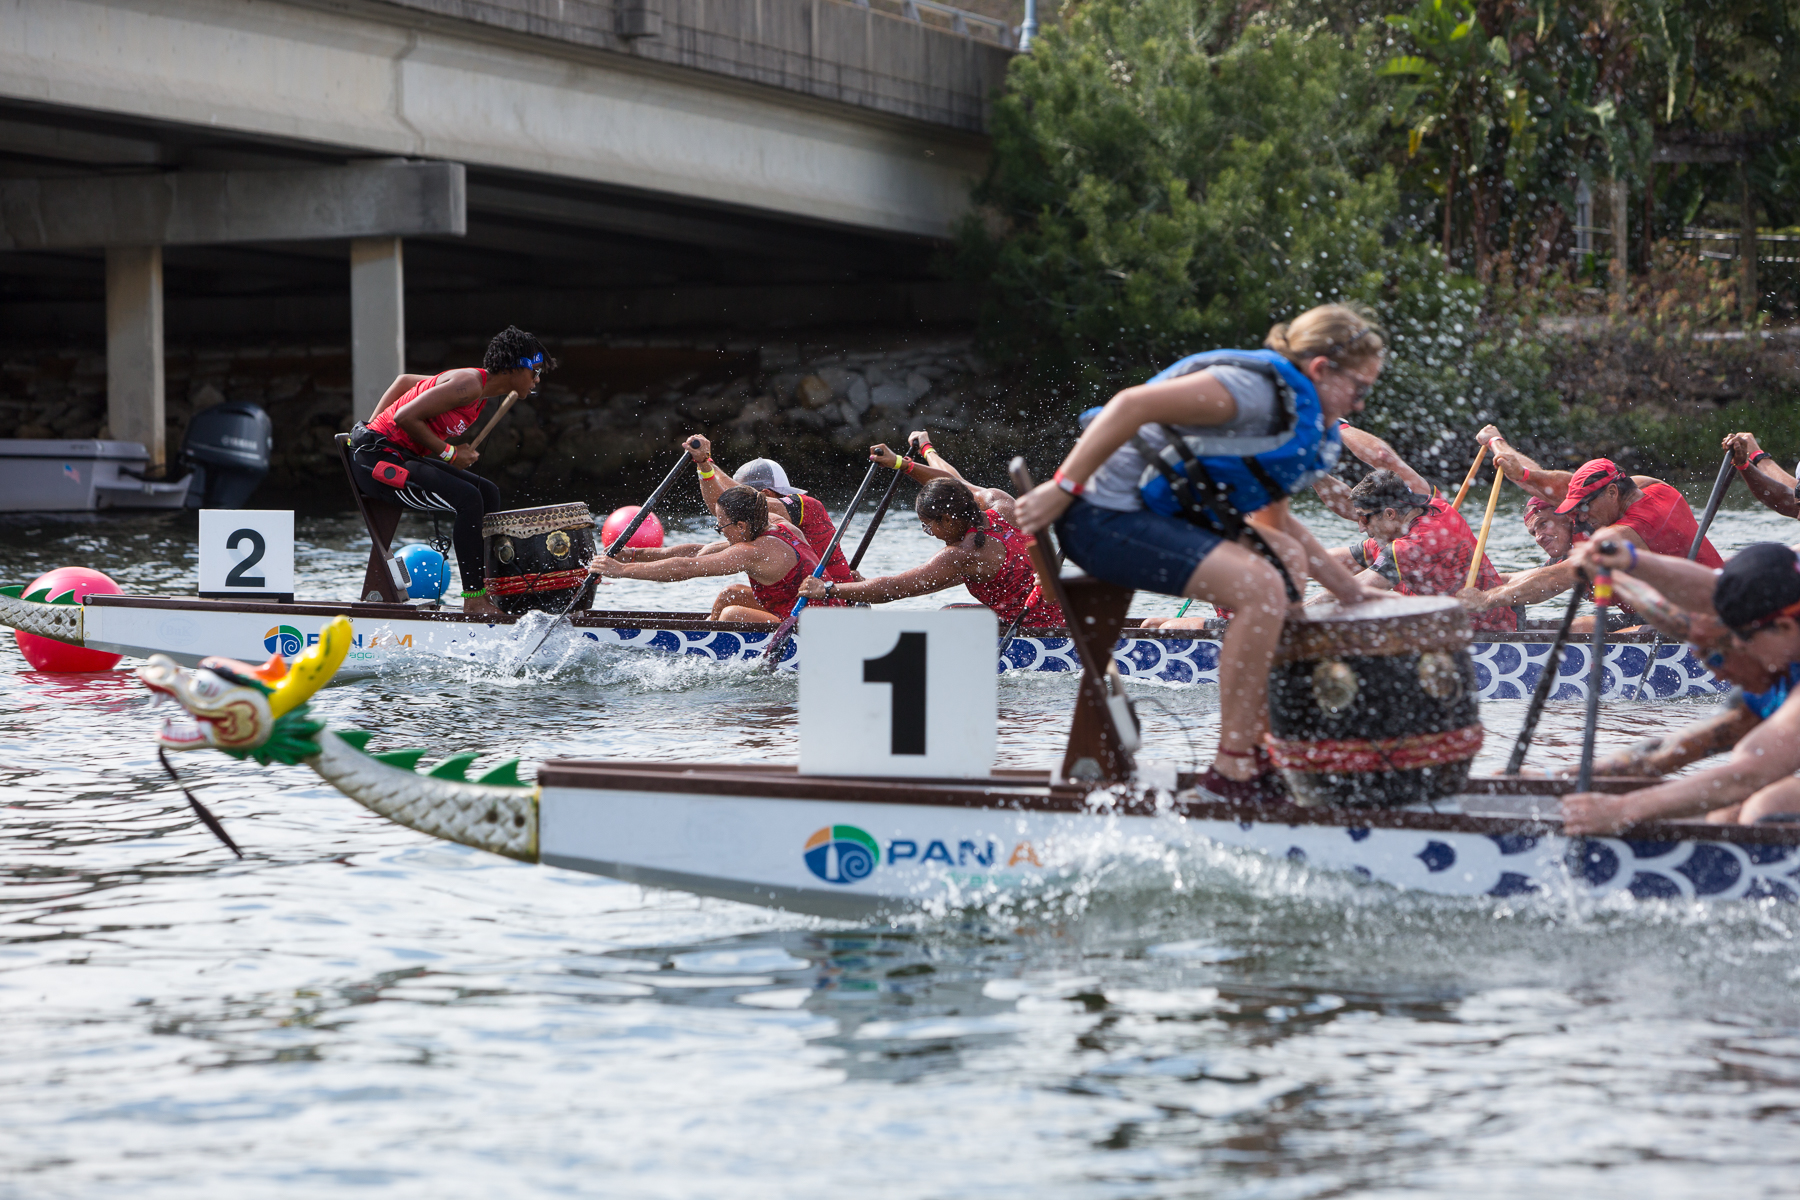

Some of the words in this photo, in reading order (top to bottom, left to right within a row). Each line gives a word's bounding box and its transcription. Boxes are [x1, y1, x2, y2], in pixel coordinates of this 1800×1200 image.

[225, 528, 266, 587] 2
[863, 631, 927, 755] 1
[886, 838, 995, 868] PAN
